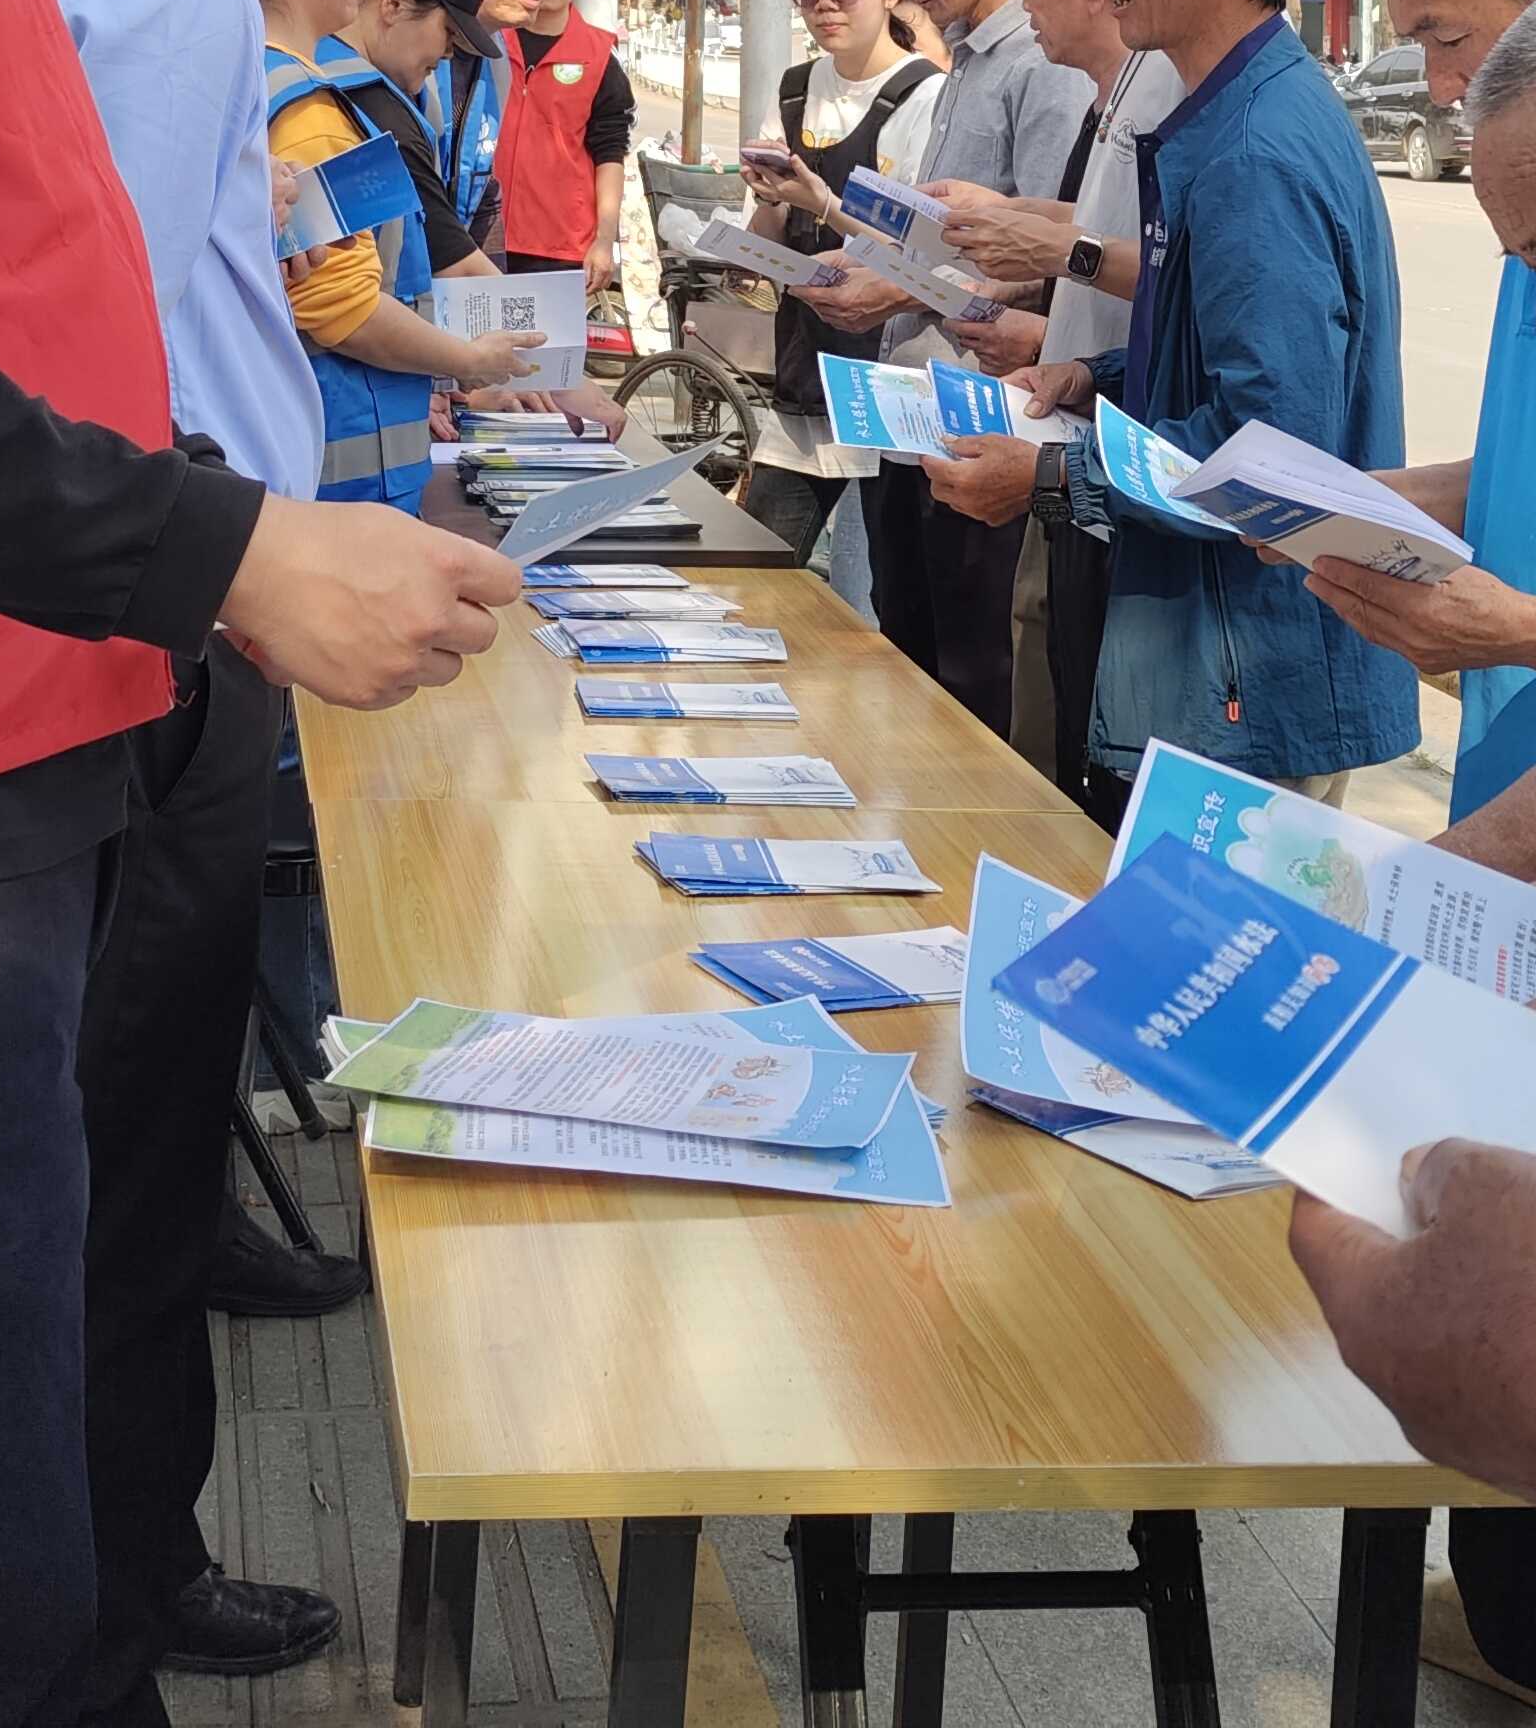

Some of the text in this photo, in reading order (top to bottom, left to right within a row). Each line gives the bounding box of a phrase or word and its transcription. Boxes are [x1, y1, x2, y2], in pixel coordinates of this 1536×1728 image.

[1017, 898, 1039, 956] 识宣传
[1133, 918, 1280, 1050] 中华人民共和国水法
